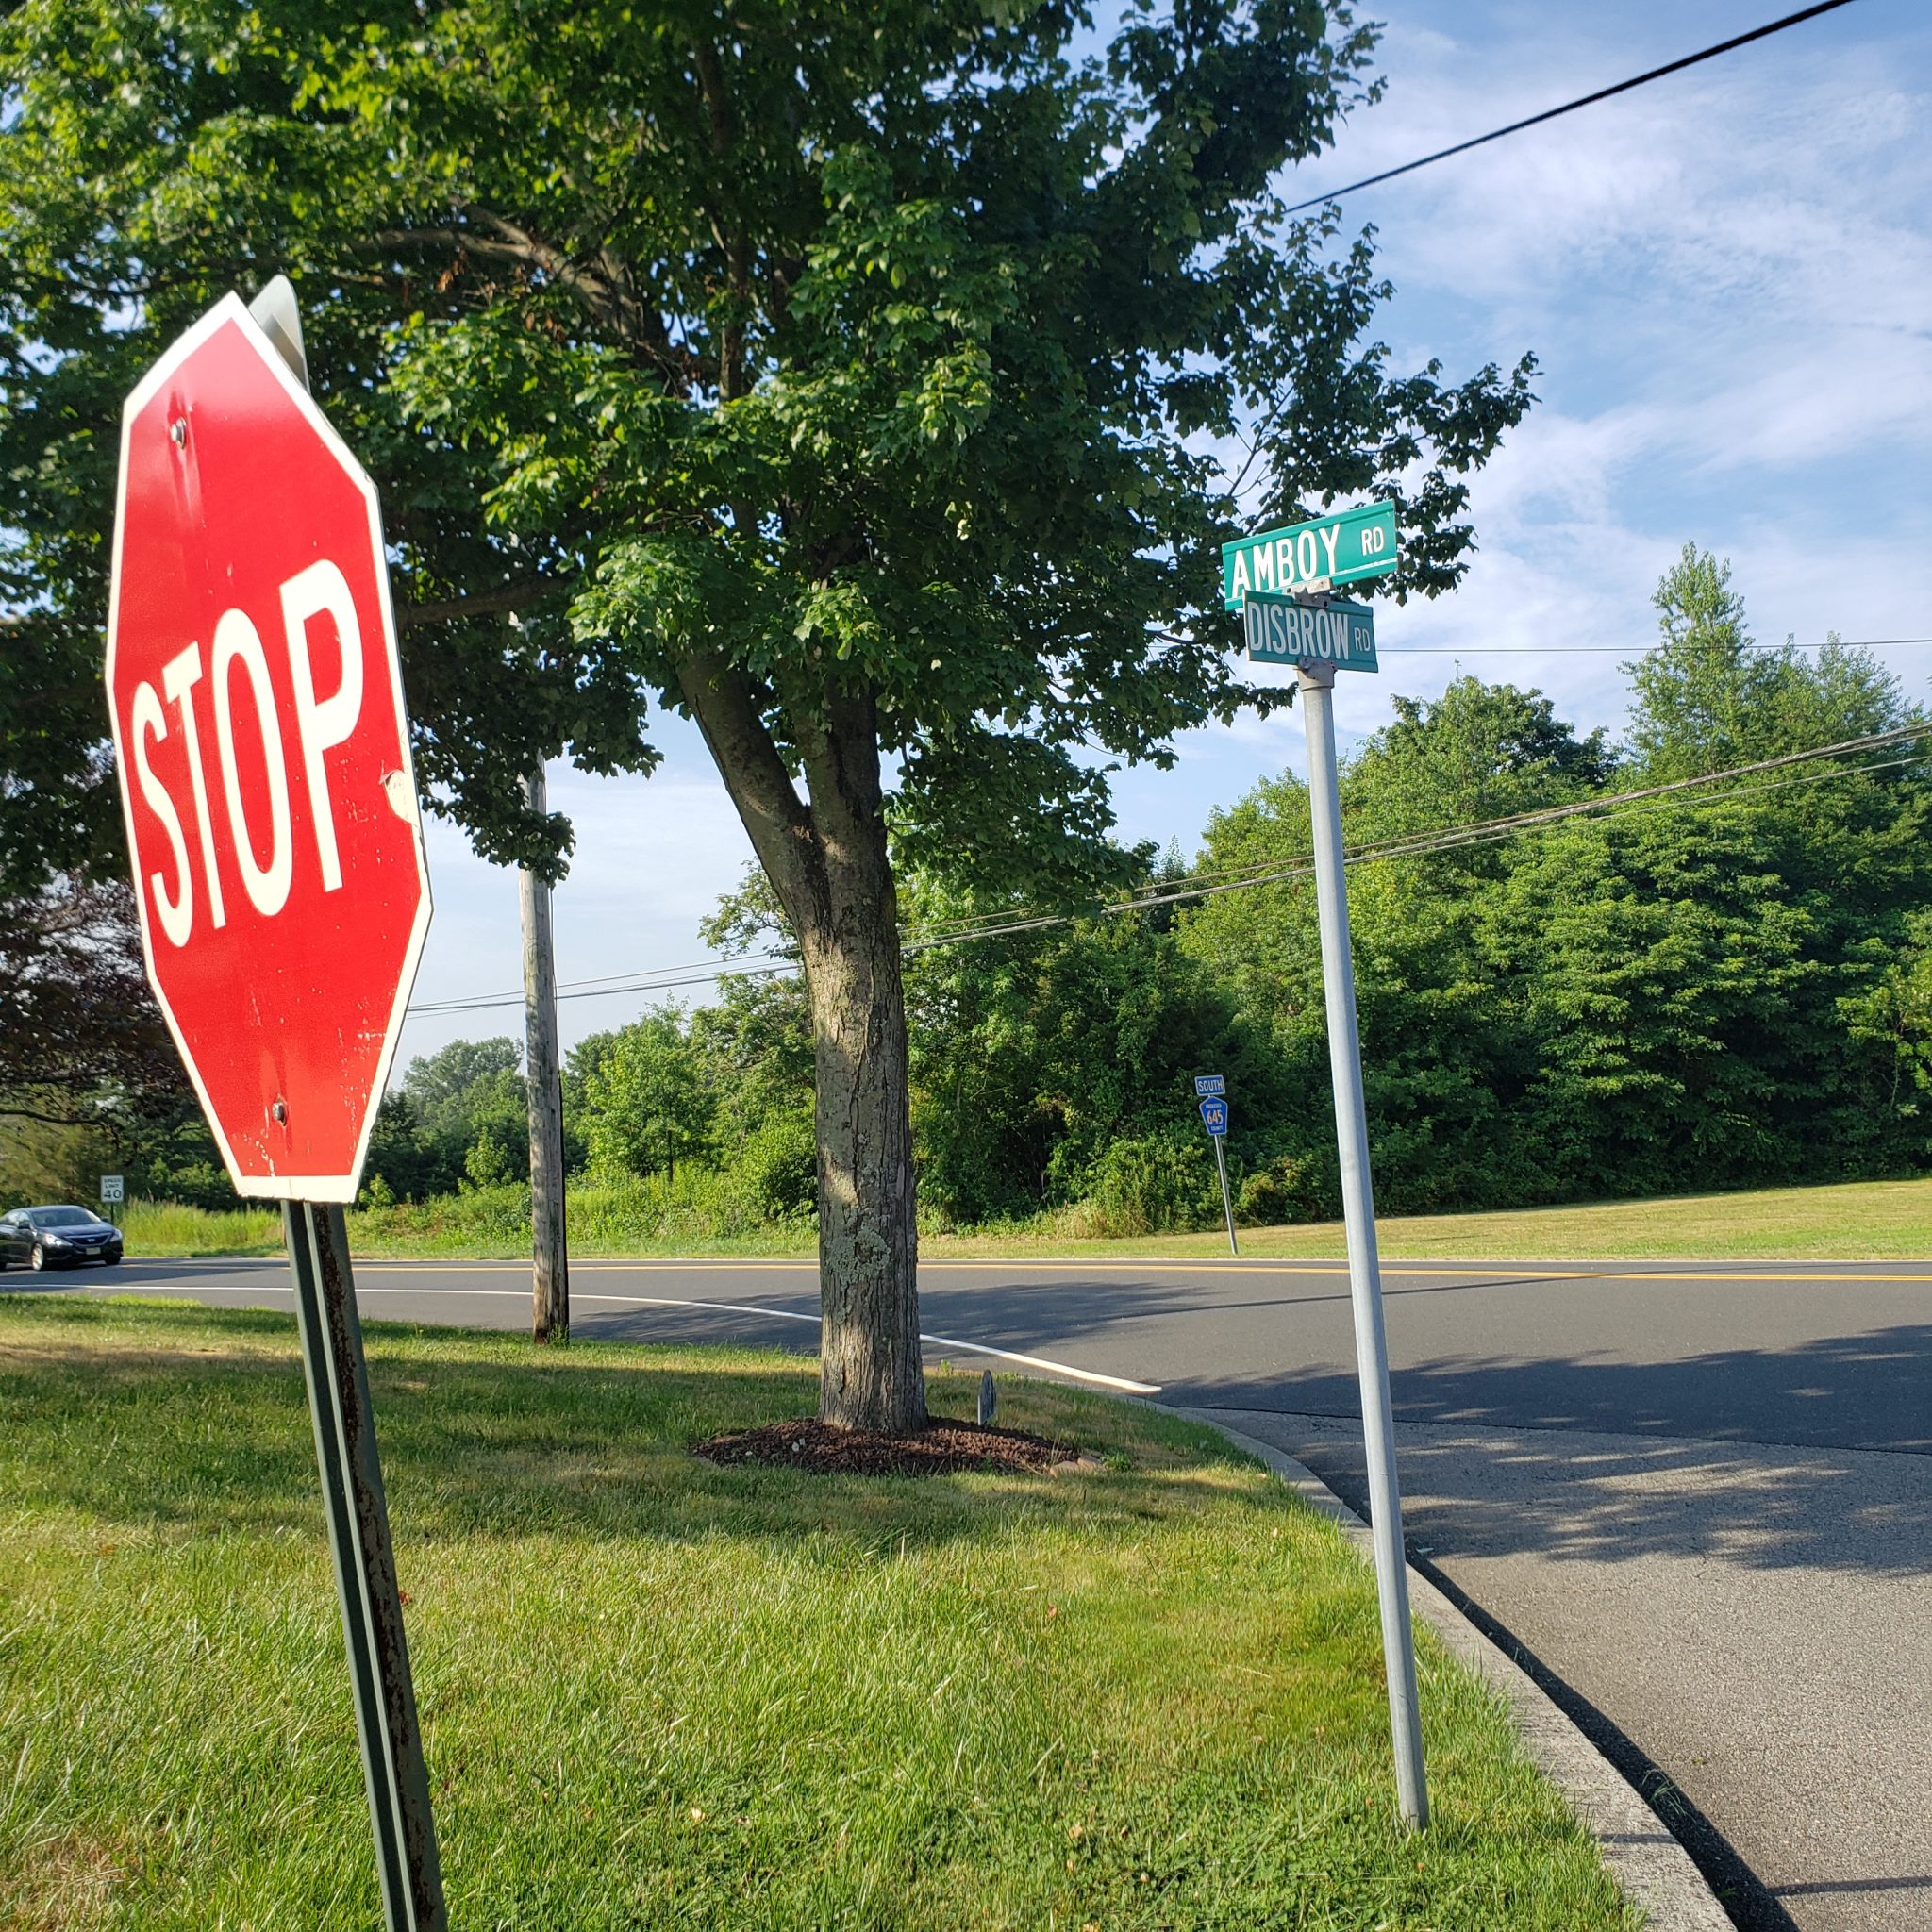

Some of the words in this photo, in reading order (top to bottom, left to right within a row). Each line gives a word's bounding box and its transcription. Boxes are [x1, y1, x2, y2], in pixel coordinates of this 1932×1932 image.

[1232, 524, 1341, 598] AMBOY
[1361, 526, 1385, 556] RD
[1247, 602, 1349, 660] DISBROW
[1354, 627, 1371, 651] RD
[132, 558, 364, 948] STOP
[1198, 1079, 1223, 1092] SOUTH
[1208, 1109, 1224, 1124] 645
[104, 1189, 122, 1199] 40
